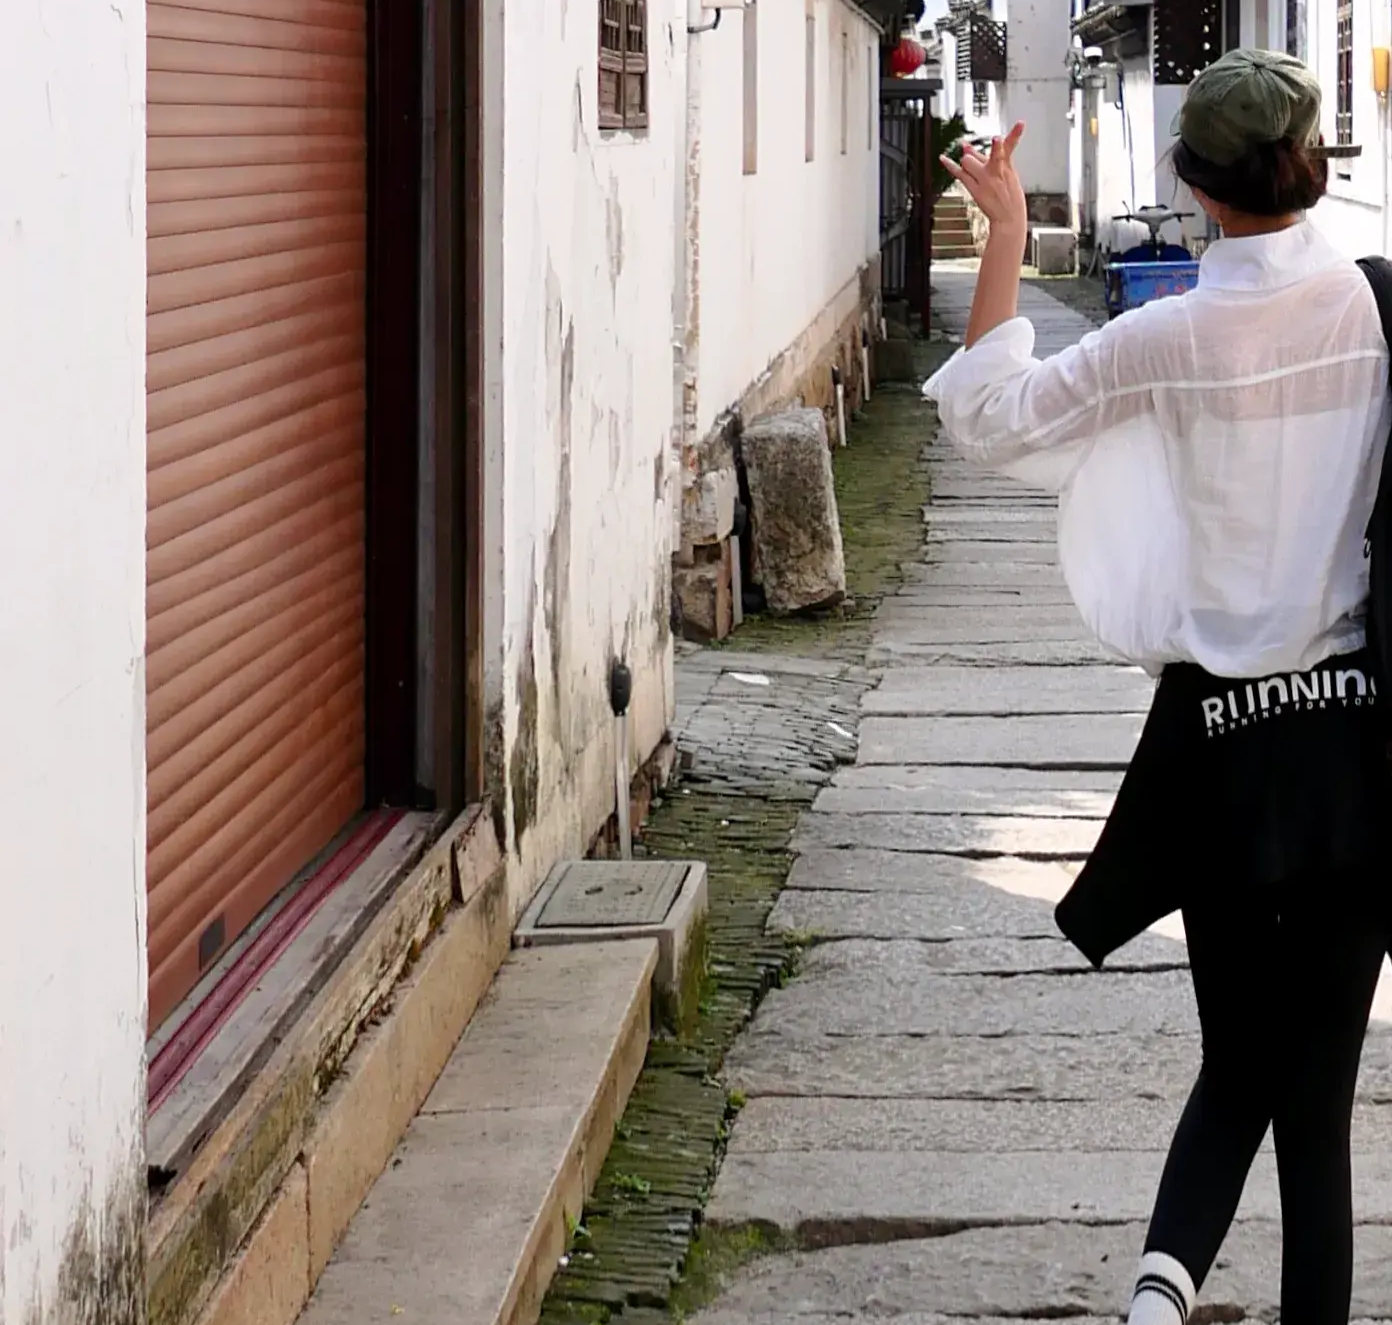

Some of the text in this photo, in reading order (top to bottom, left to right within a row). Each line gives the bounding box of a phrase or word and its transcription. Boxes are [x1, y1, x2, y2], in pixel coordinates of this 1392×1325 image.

[1207, 697, 1375, 738] RUNNING FOR YOU
